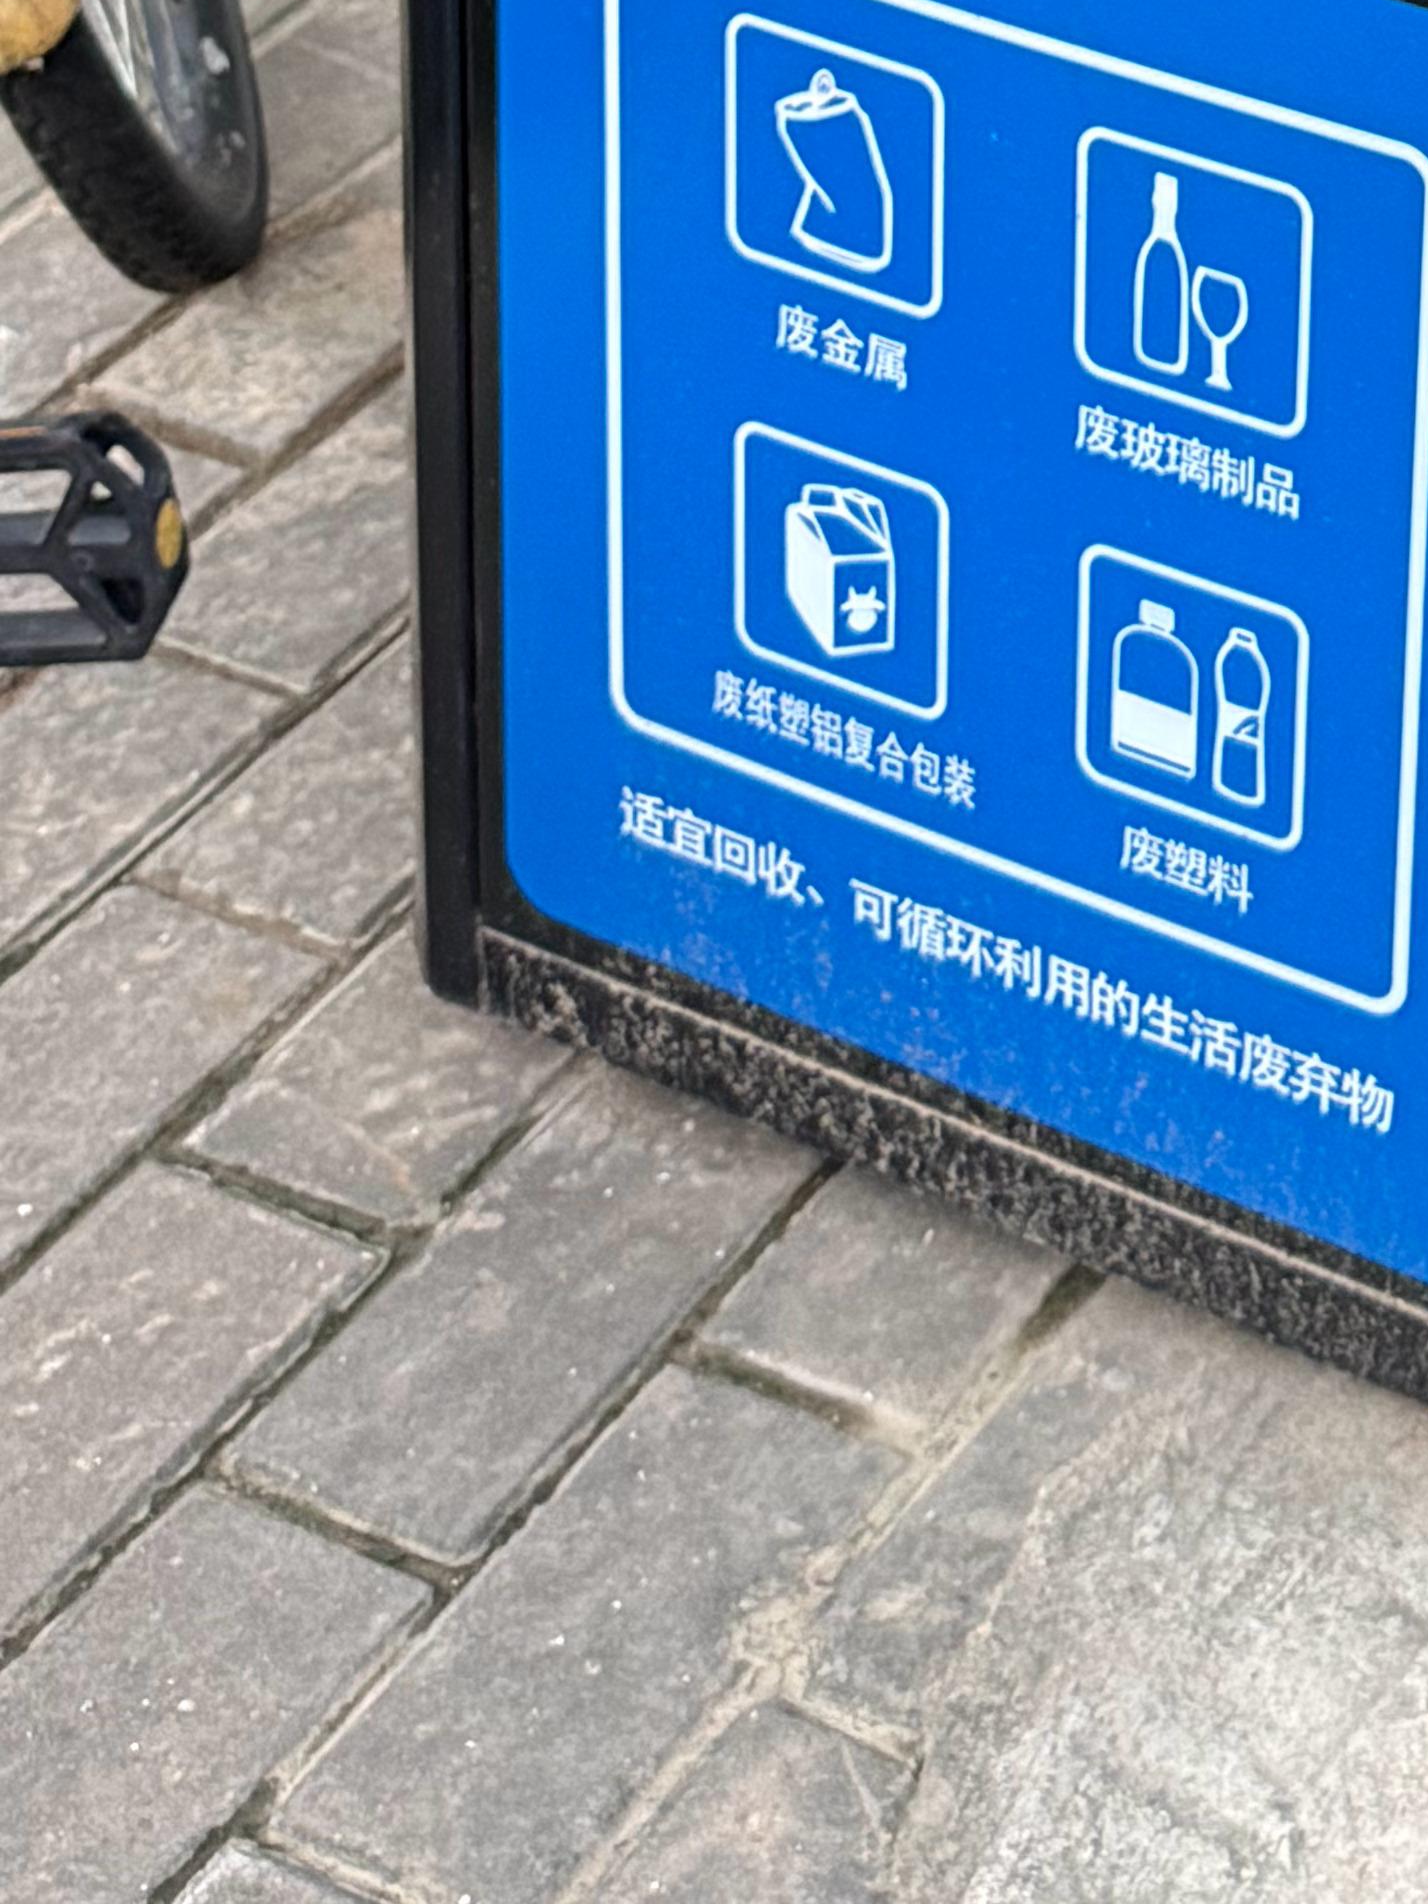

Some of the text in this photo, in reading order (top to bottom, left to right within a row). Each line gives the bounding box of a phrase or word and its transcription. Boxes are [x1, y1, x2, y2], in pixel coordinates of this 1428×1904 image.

[774, 303, 908, 390] 废金属
[1074, 404, 1301, 519] 废玻璃制品
[713, 670, 976, 808] 废纸塑铝复合包装
[1119, 825, 1253, 913] 废塑料
[618, 786, 1395, 1134] 适宜回收、可循环利用的生活废弃物
